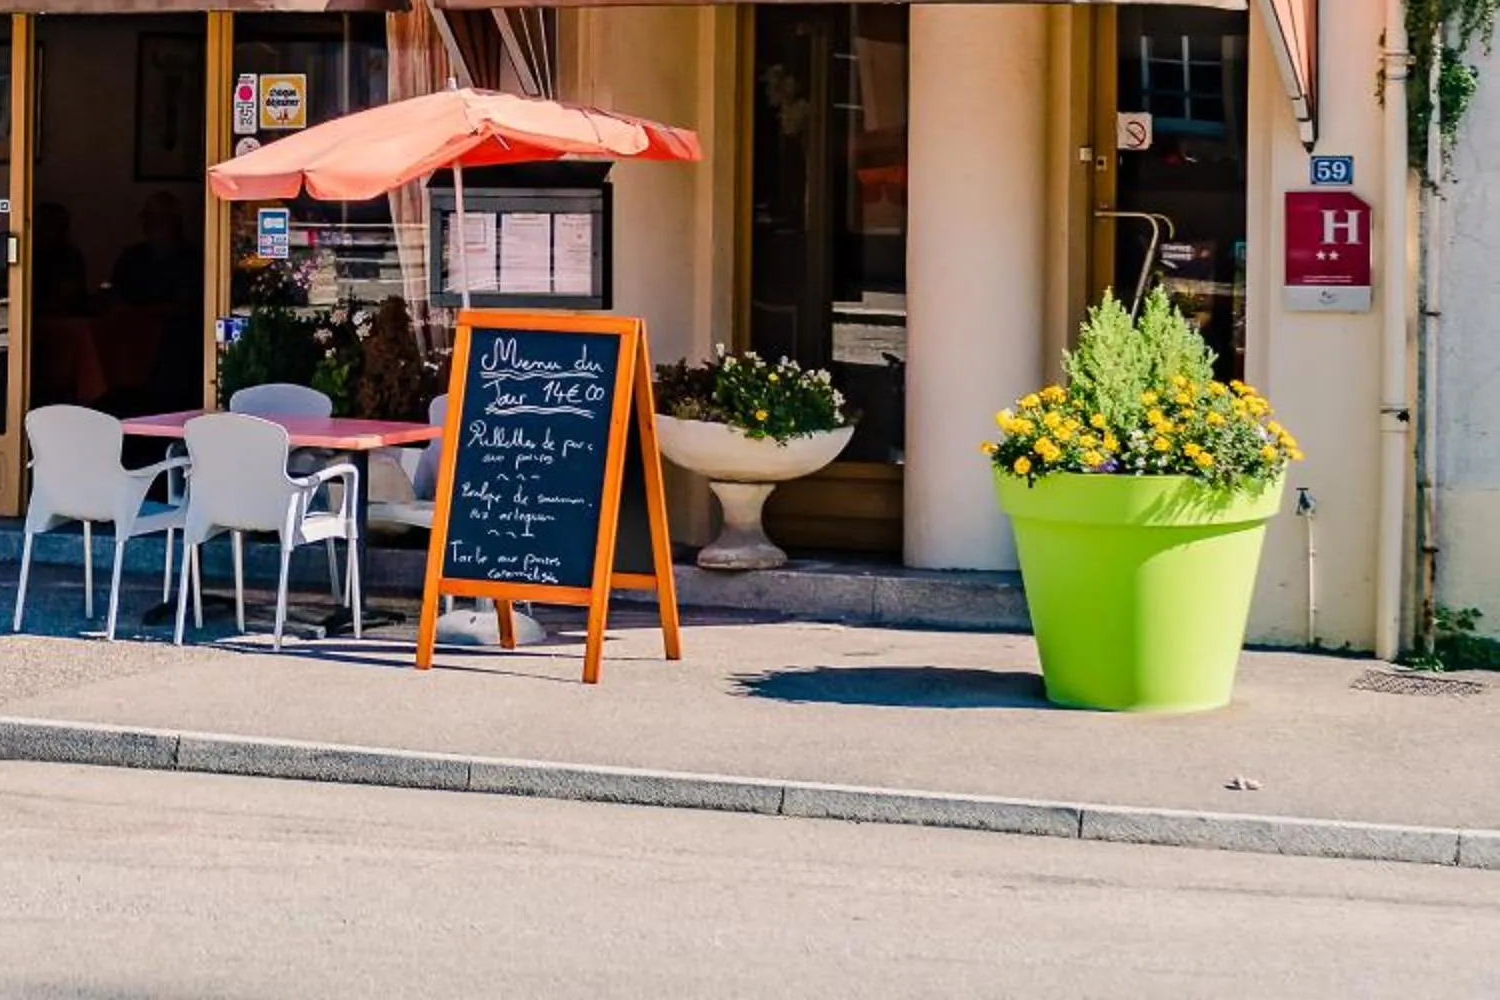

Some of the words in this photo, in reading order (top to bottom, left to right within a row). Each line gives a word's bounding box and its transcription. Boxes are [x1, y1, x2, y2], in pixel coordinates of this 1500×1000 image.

[1316, 161, 1347, 181] 59
[1320, 209, 1362, 245] H
[480, 336, 561, 371] Menu
[573, 343, 604, 372] du
[467, 419, 536, 449] Rillettes
[541, 426, 555, 451] de
[561, 439, 593, 458] porc
[513, 483, 529, 506] de
[450, 540, 487, 565] Tarte
